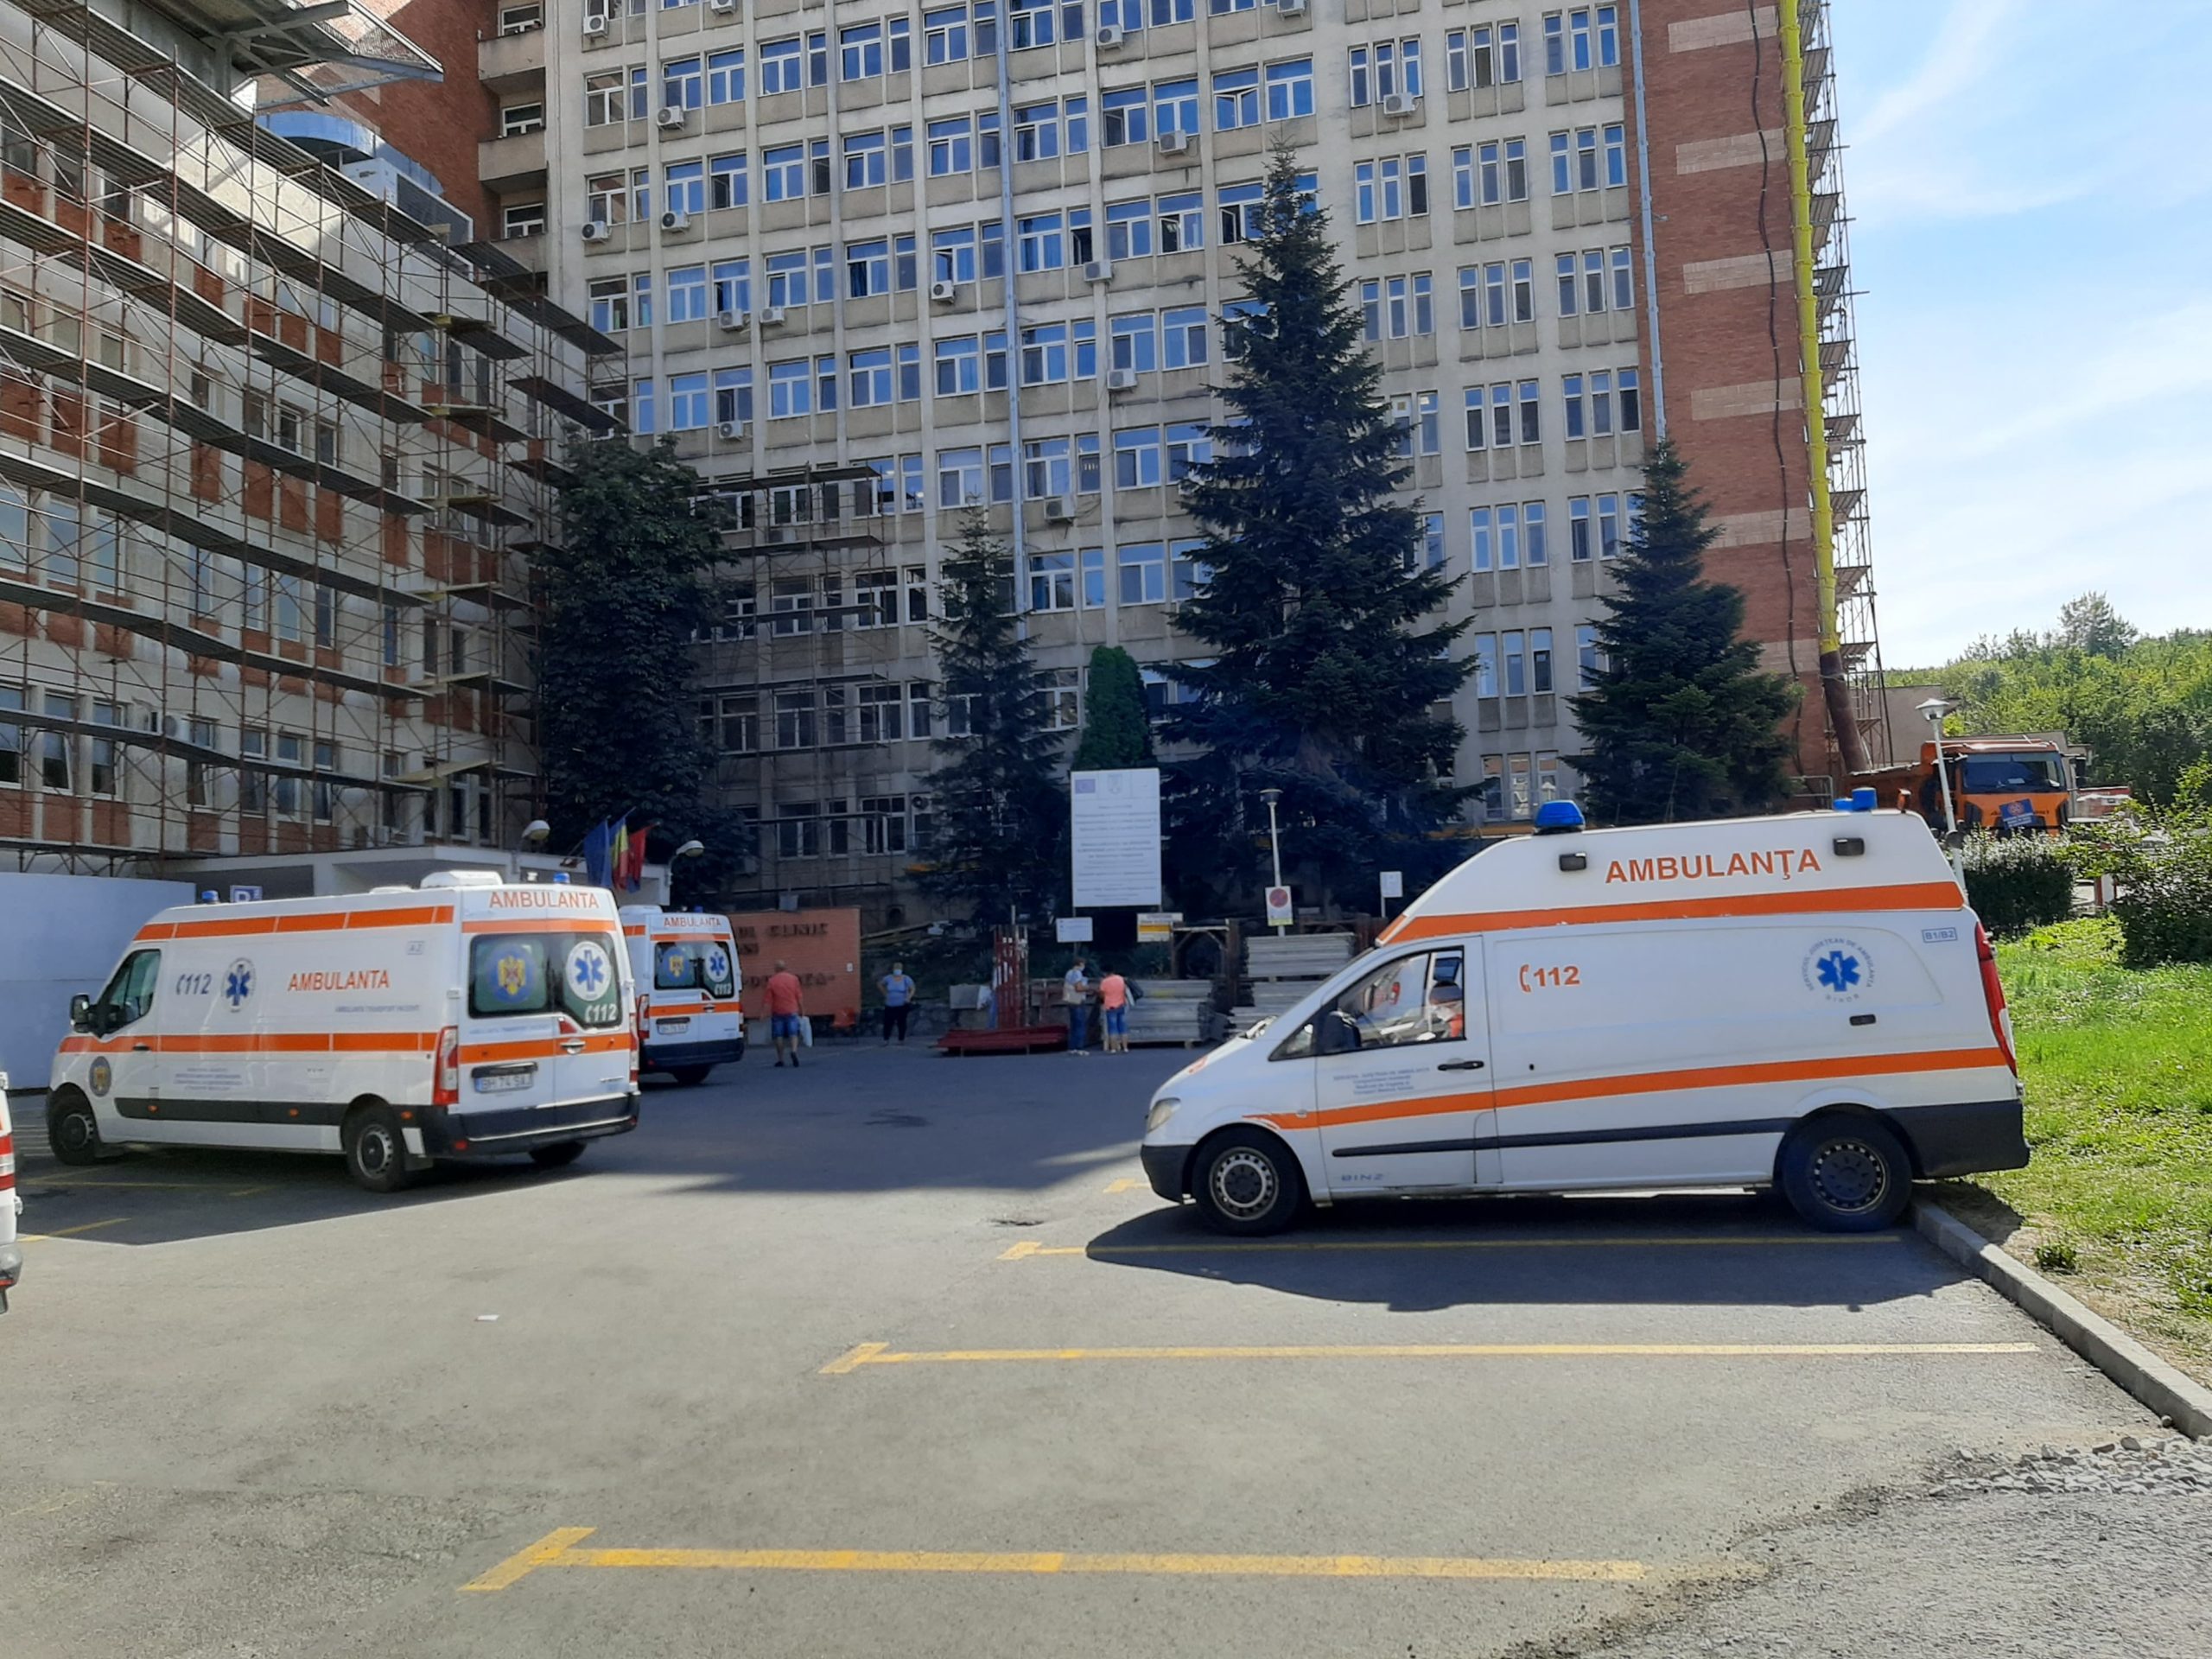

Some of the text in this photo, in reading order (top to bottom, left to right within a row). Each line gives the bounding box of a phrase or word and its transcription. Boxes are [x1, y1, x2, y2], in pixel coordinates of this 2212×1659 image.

[489, 891, 599, 909] AMBULANTA
[664, 917, 721, 927] AMBULANTA
[1924, 931, 1955, 941] B1/B2
[184, 974, 213, 995] 112
[287, 969, 391, 992] AMBULANTA
[1533, 965, 1580, 987] 112
[719, 983, 733, 995] 112
[594, 1003, 618, 1020] 112
